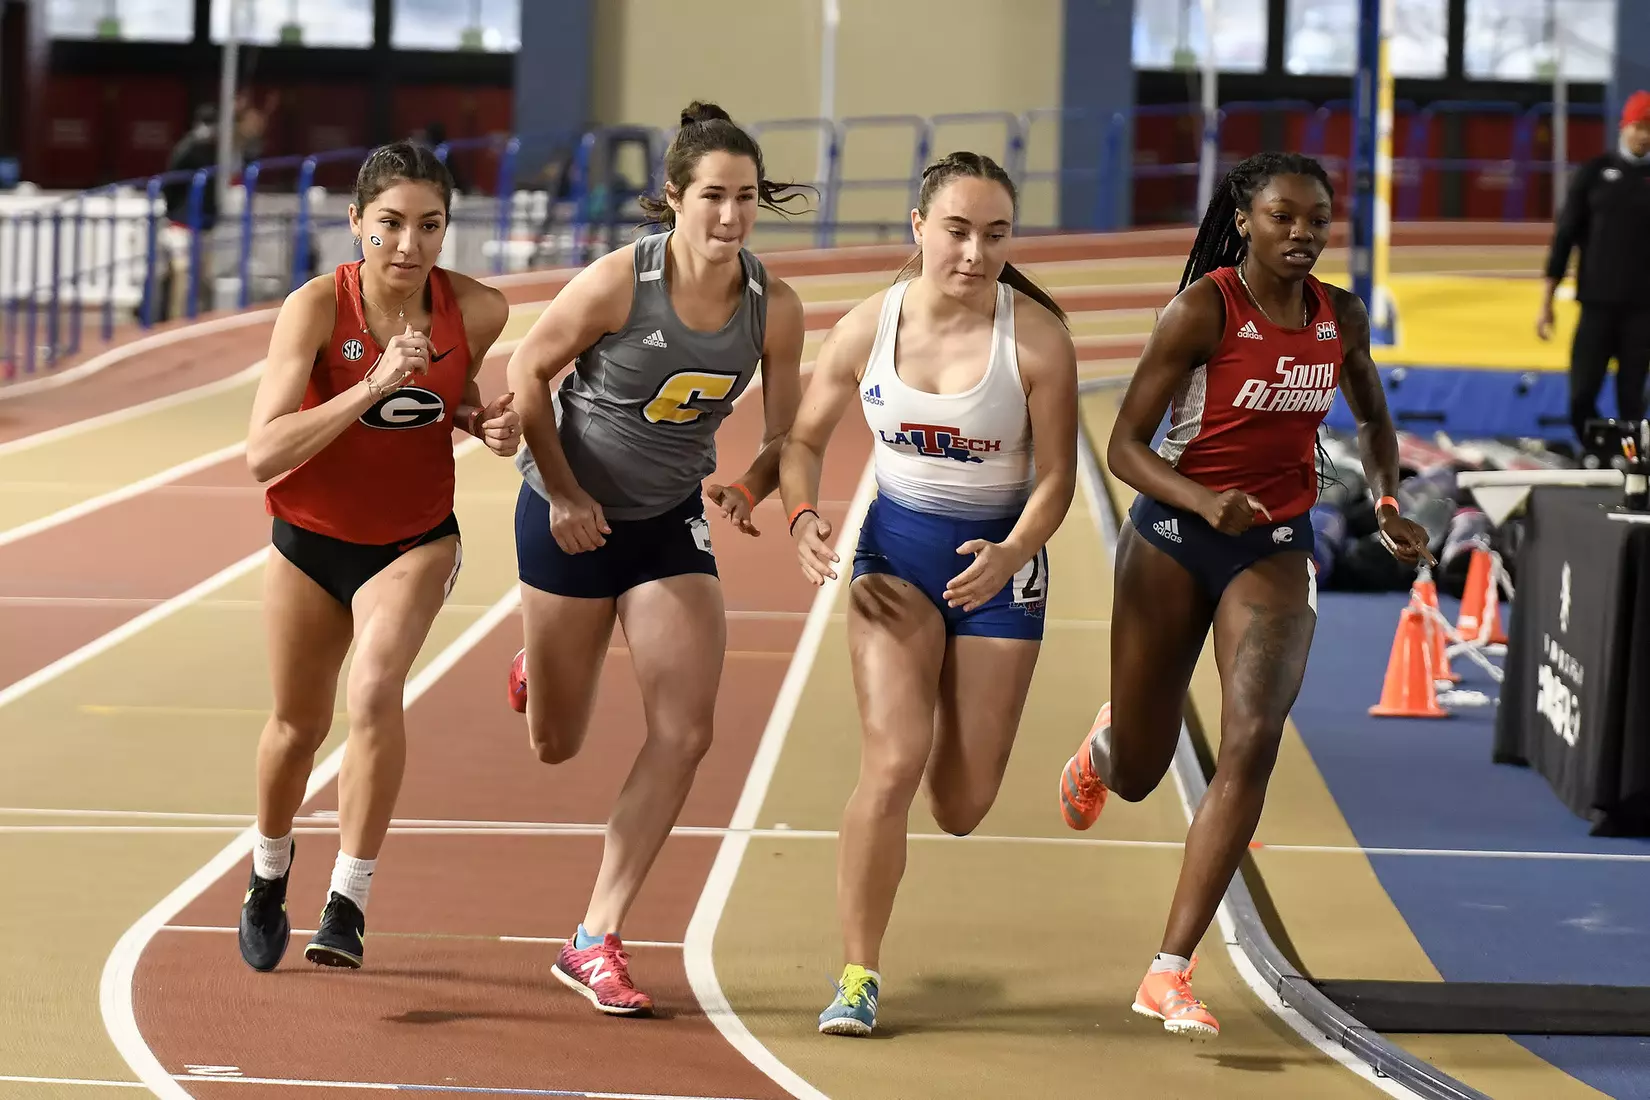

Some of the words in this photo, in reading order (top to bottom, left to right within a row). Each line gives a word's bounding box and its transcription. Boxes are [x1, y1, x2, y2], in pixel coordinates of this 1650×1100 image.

[643, 338, 668, 349] adidas
[1237, 331, 1263, 341] adidas
[343, 342, 363, 359] SEC
[642, 369, 740, 424] C
[377, 395, 445, 425] G
[1152, 522, 1183, 544] adidas
